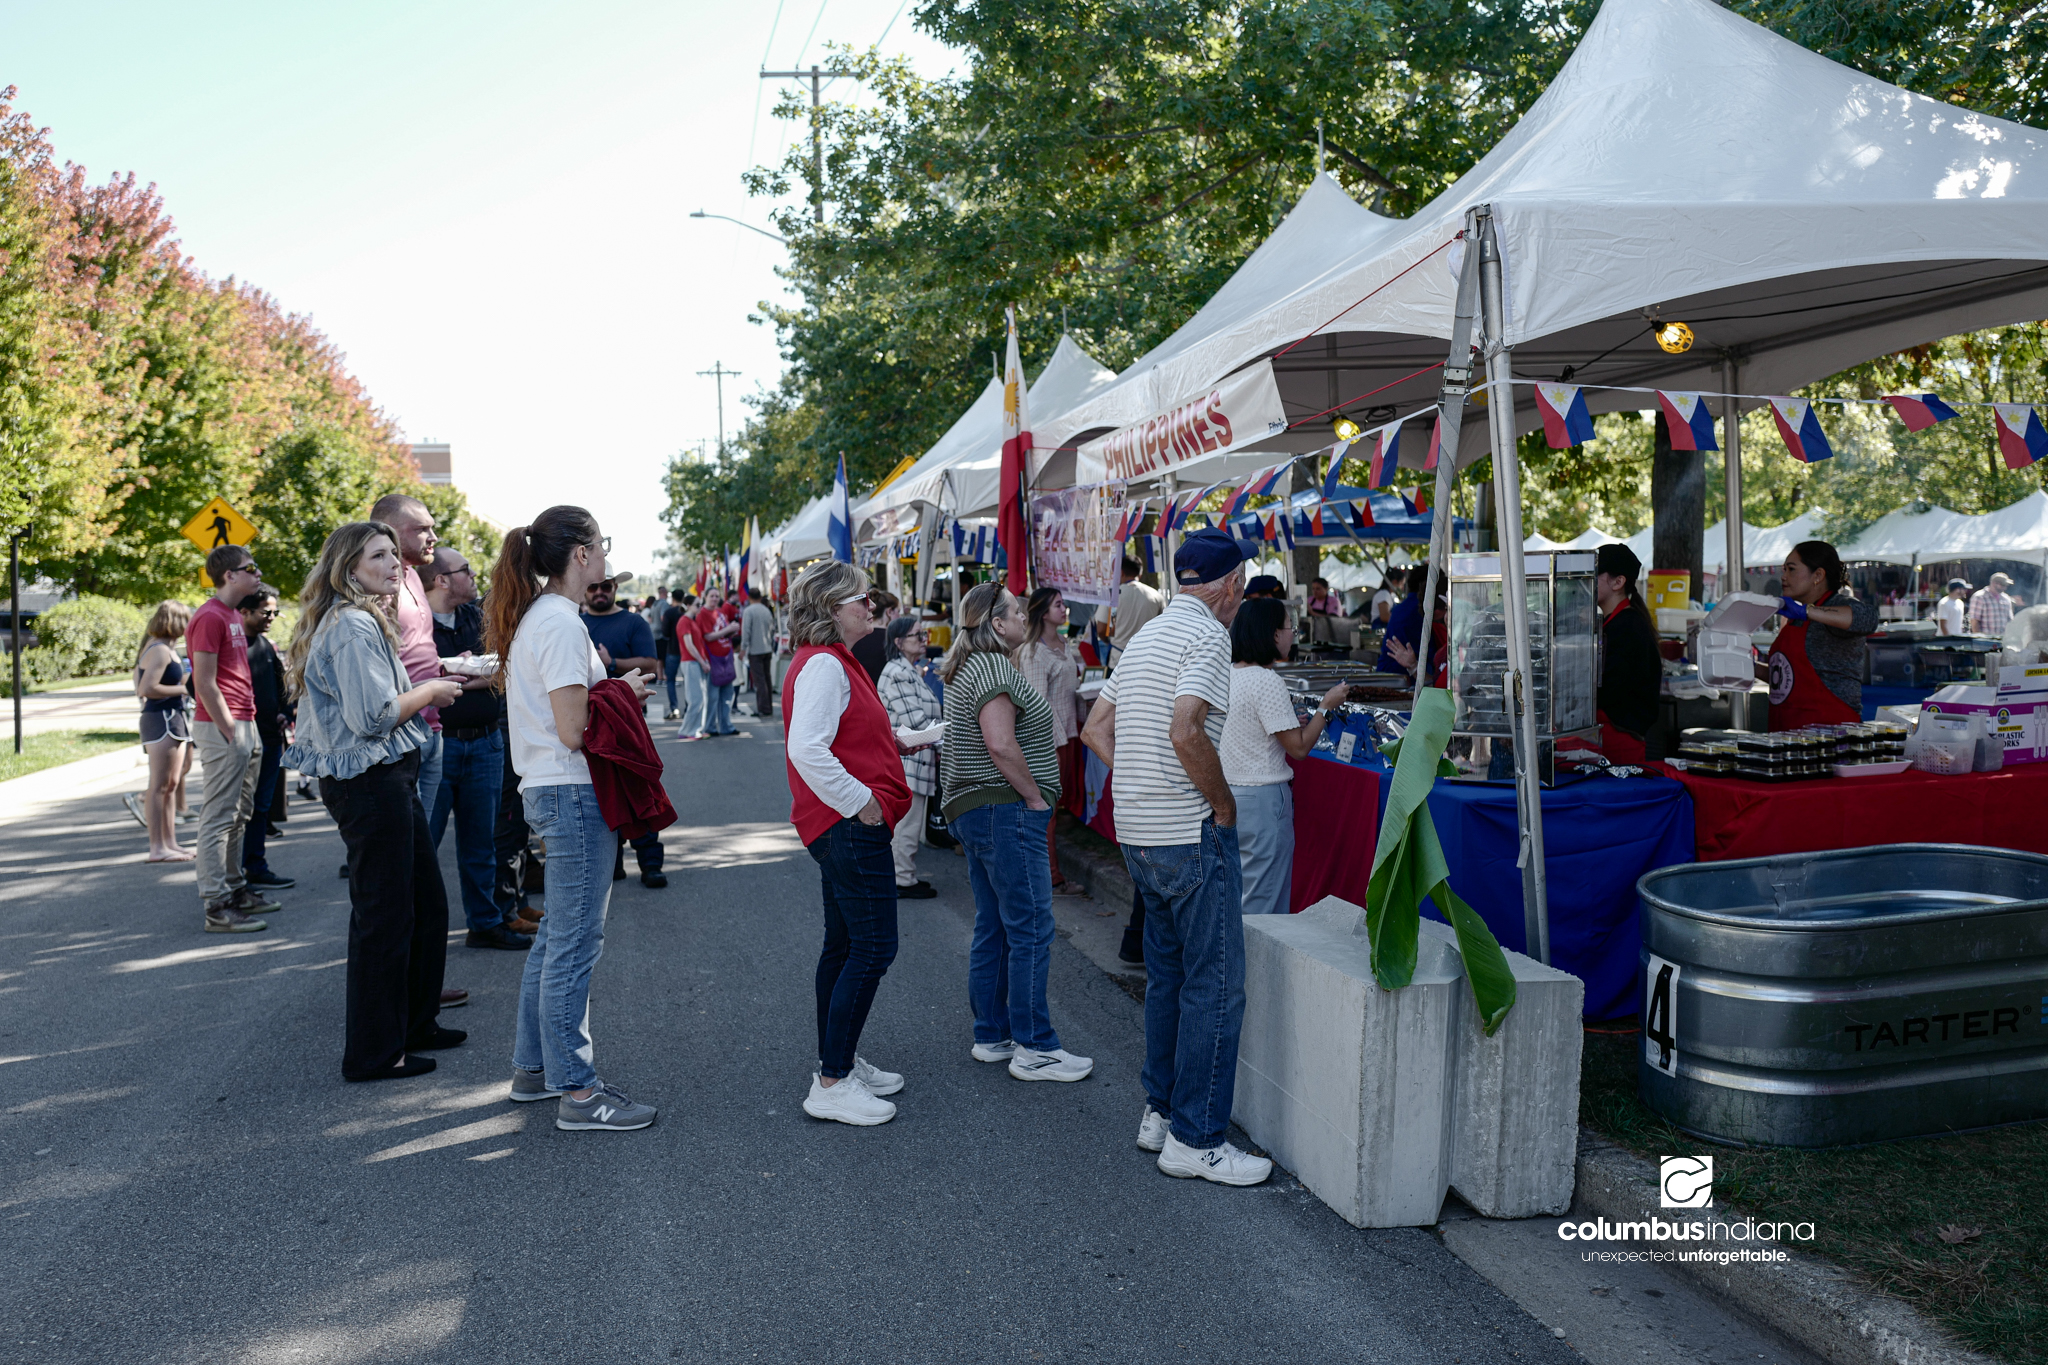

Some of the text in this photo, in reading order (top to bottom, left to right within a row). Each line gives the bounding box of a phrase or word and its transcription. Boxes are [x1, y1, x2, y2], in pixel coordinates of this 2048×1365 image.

[1103, 390, 1233, 481] PHILIPPINES
[2003, 739, 2020, 747] ORKS
[1647, 963, 1676, 1071] 4
[591, 1104, 616, 1123] N
